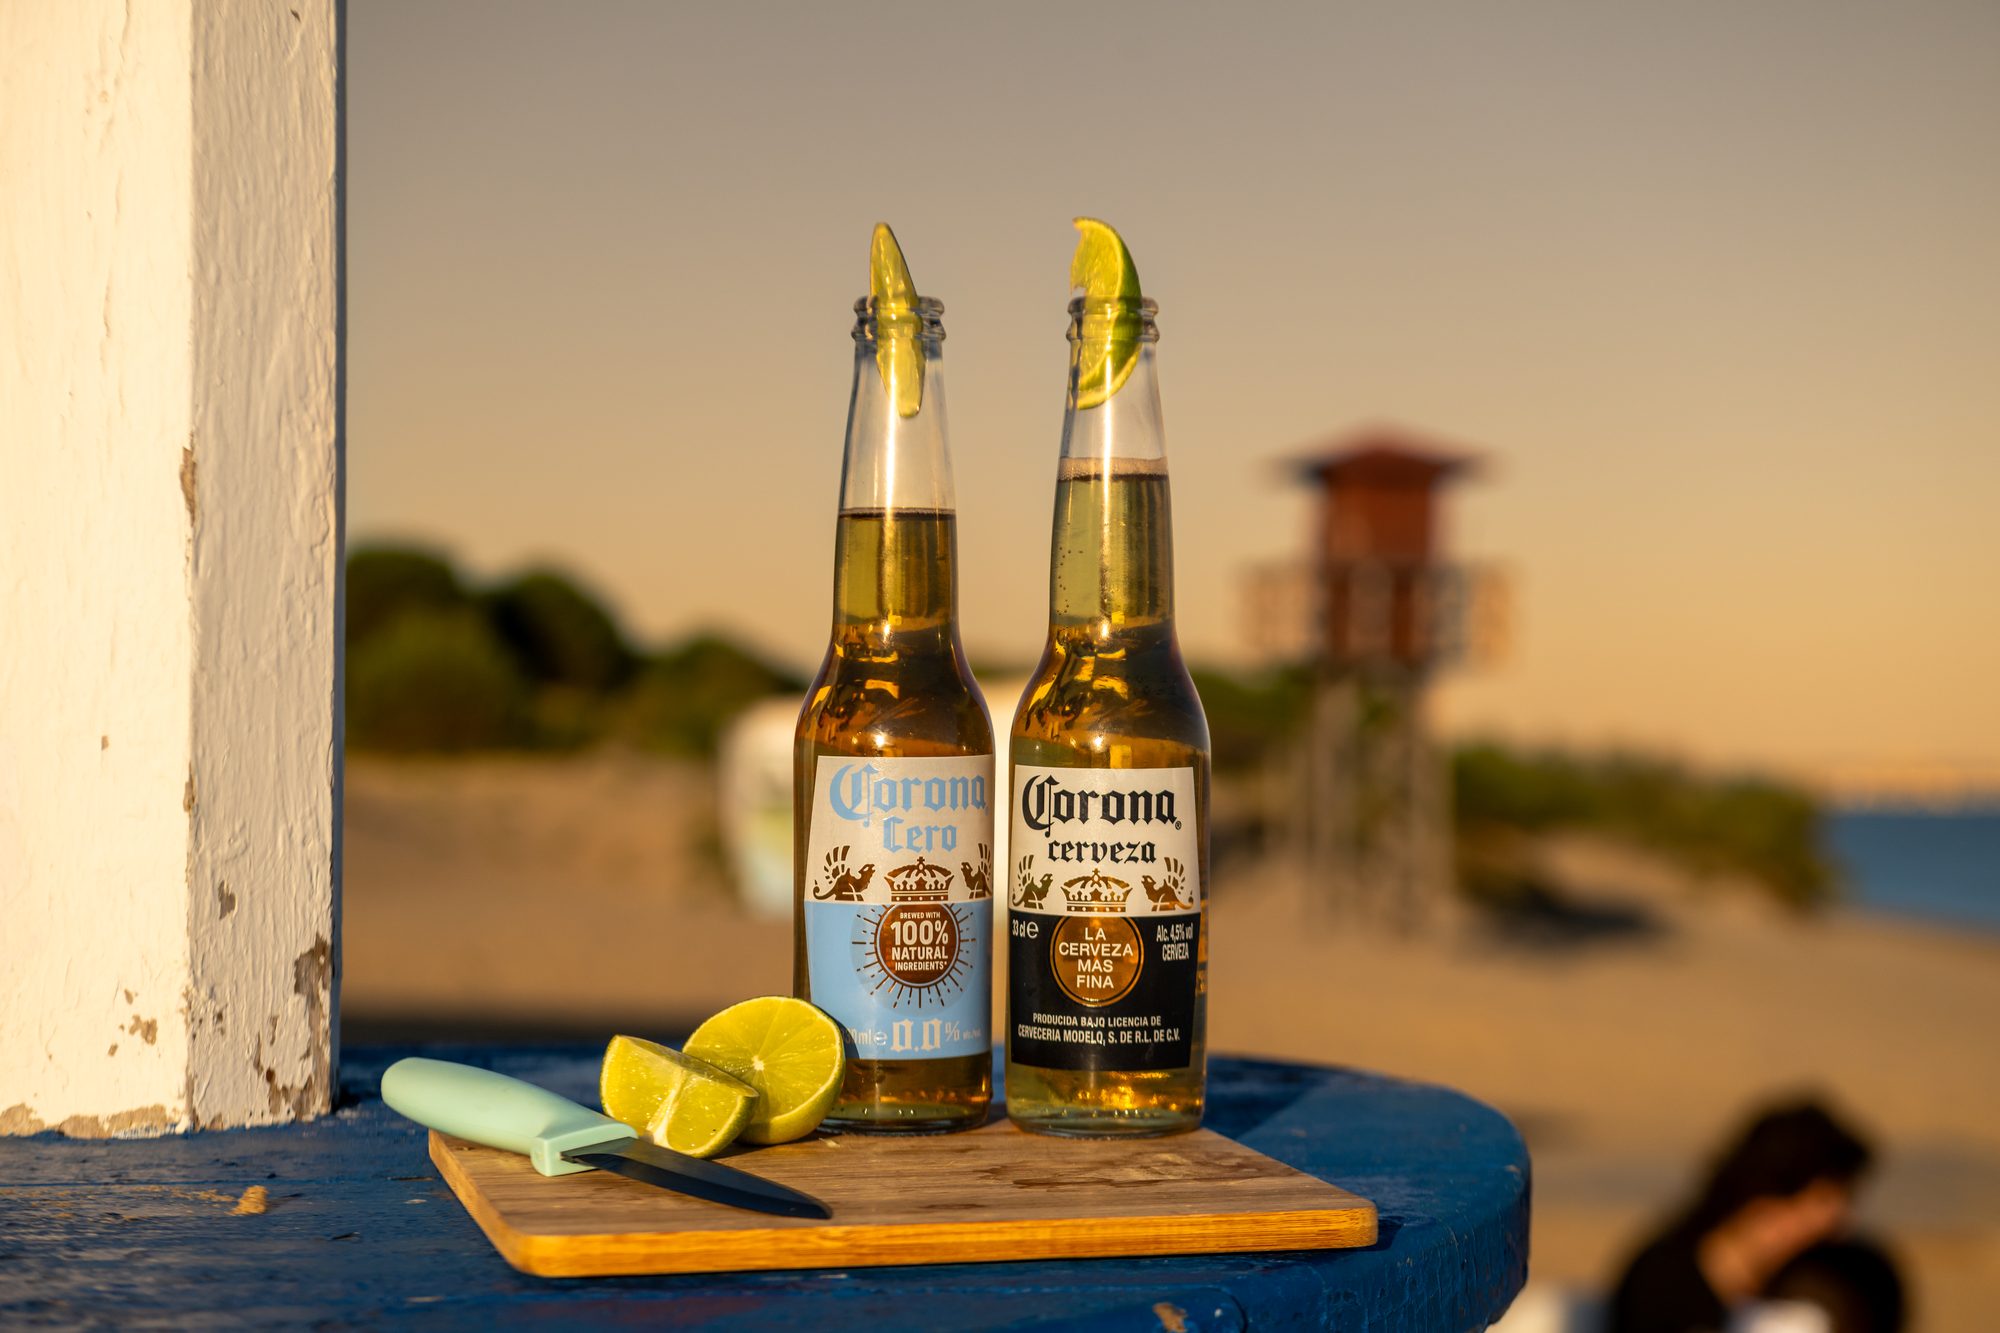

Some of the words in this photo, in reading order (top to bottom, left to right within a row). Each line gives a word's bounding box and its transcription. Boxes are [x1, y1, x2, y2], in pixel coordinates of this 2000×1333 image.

[829, 763, 987, 828] Corona
[883, 815, 957, 853] Cero
[1048, 840, 1157, 864] cerveza
[900, 911, 925, 919] BREWED
[925, 911, 941, 919] WITH
[890, 919, 949, 946] 100%
[1084, 927, 1107, 941] LA
[891, 946, 949, 961] NATURAL
[1058, 942, 1134, 957] CERVEZA
[1162, 942, 1190, 962] CERVEZA
[1077, 959, 1114, 973] MAS
[1076, 975, 1114, 988] FINA
[1033, 1012, 1078, 1027] PRODUCIDA
[1108, 1016, 1149, 1028] LICENCIA
[1151, 1015, 1162, 1027] DE
[1018, 1024, 1061, 1042] CERVECERIA
[1108, 1031, 1118, 1044] S.
[1120, 1031, 1133, 1044] DE
[1135, 1030, 1152, 1044] R.L.
[1154, 1029, 1165, 1043] DE
[1166, 1028, 1180, 1041] C.V.
